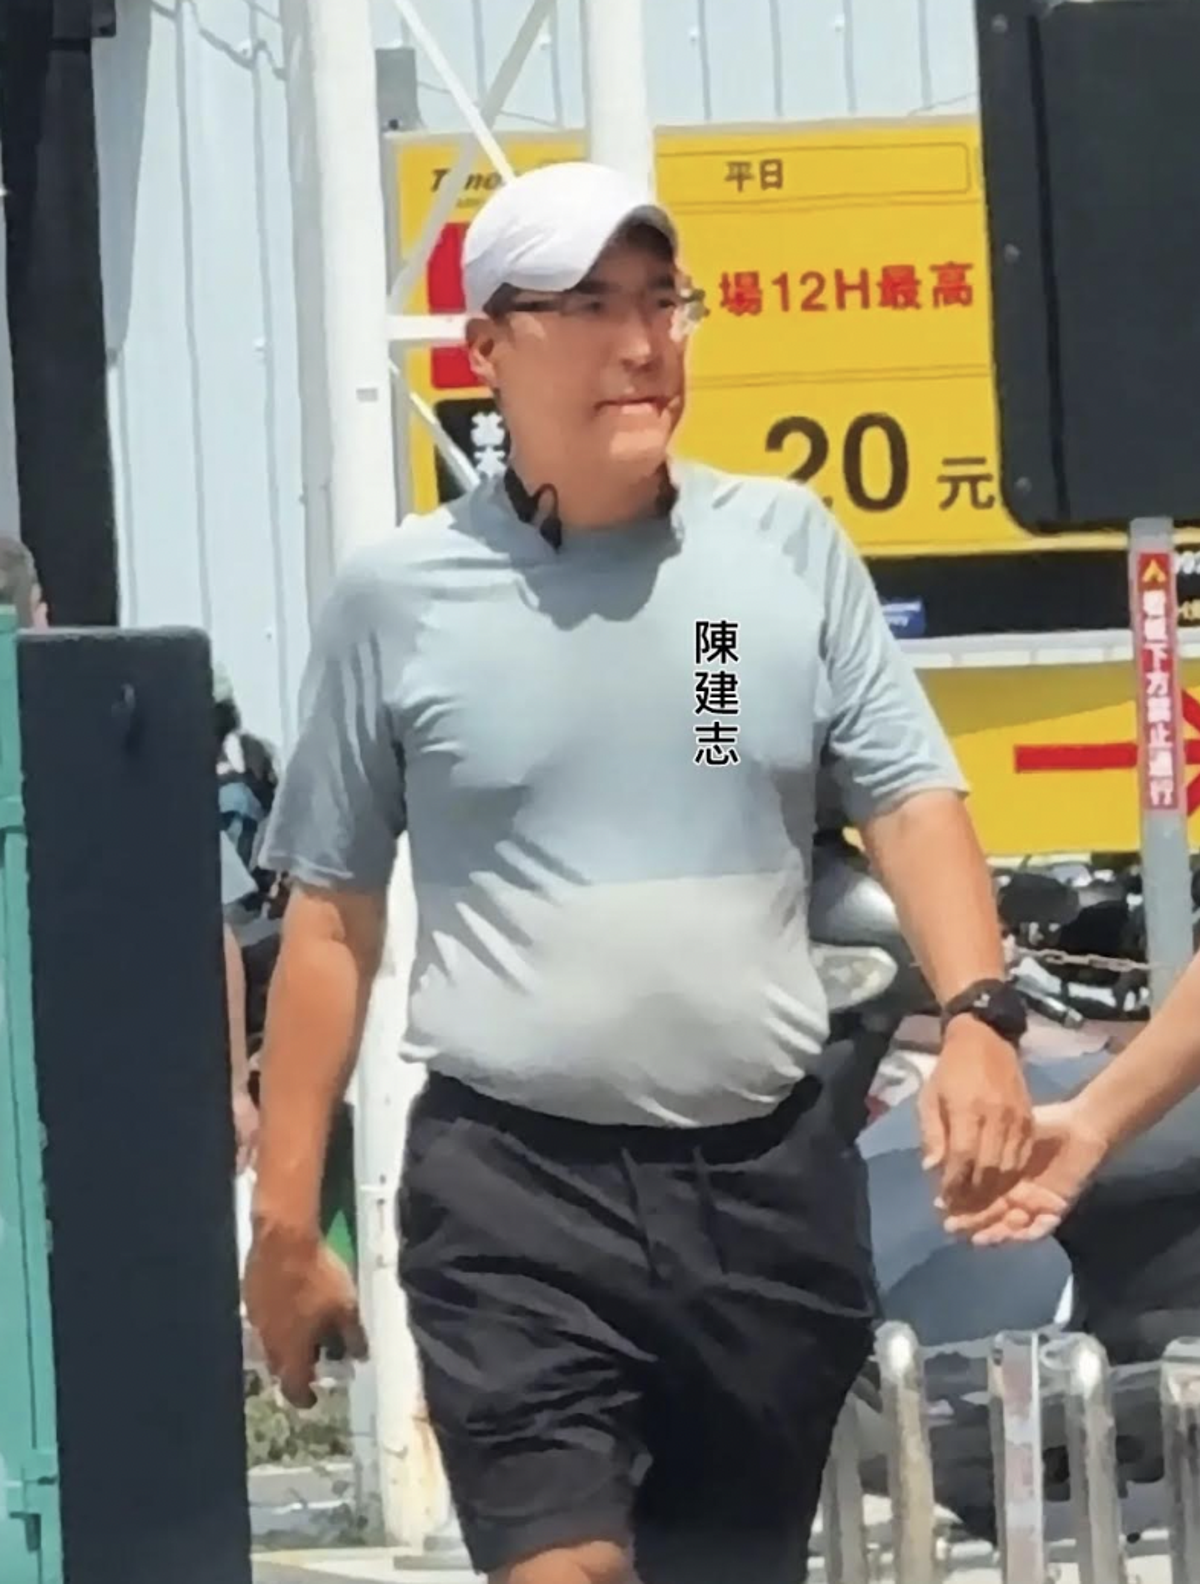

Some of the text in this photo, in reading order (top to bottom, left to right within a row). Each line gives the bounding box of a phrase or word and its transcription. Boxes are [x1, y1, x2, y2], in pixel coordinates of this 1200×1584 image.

[724, 158, 783, 192] 平日
[700, 260, 973, 317] 場12H最高
[765, 412, 995, 512] 20 元
